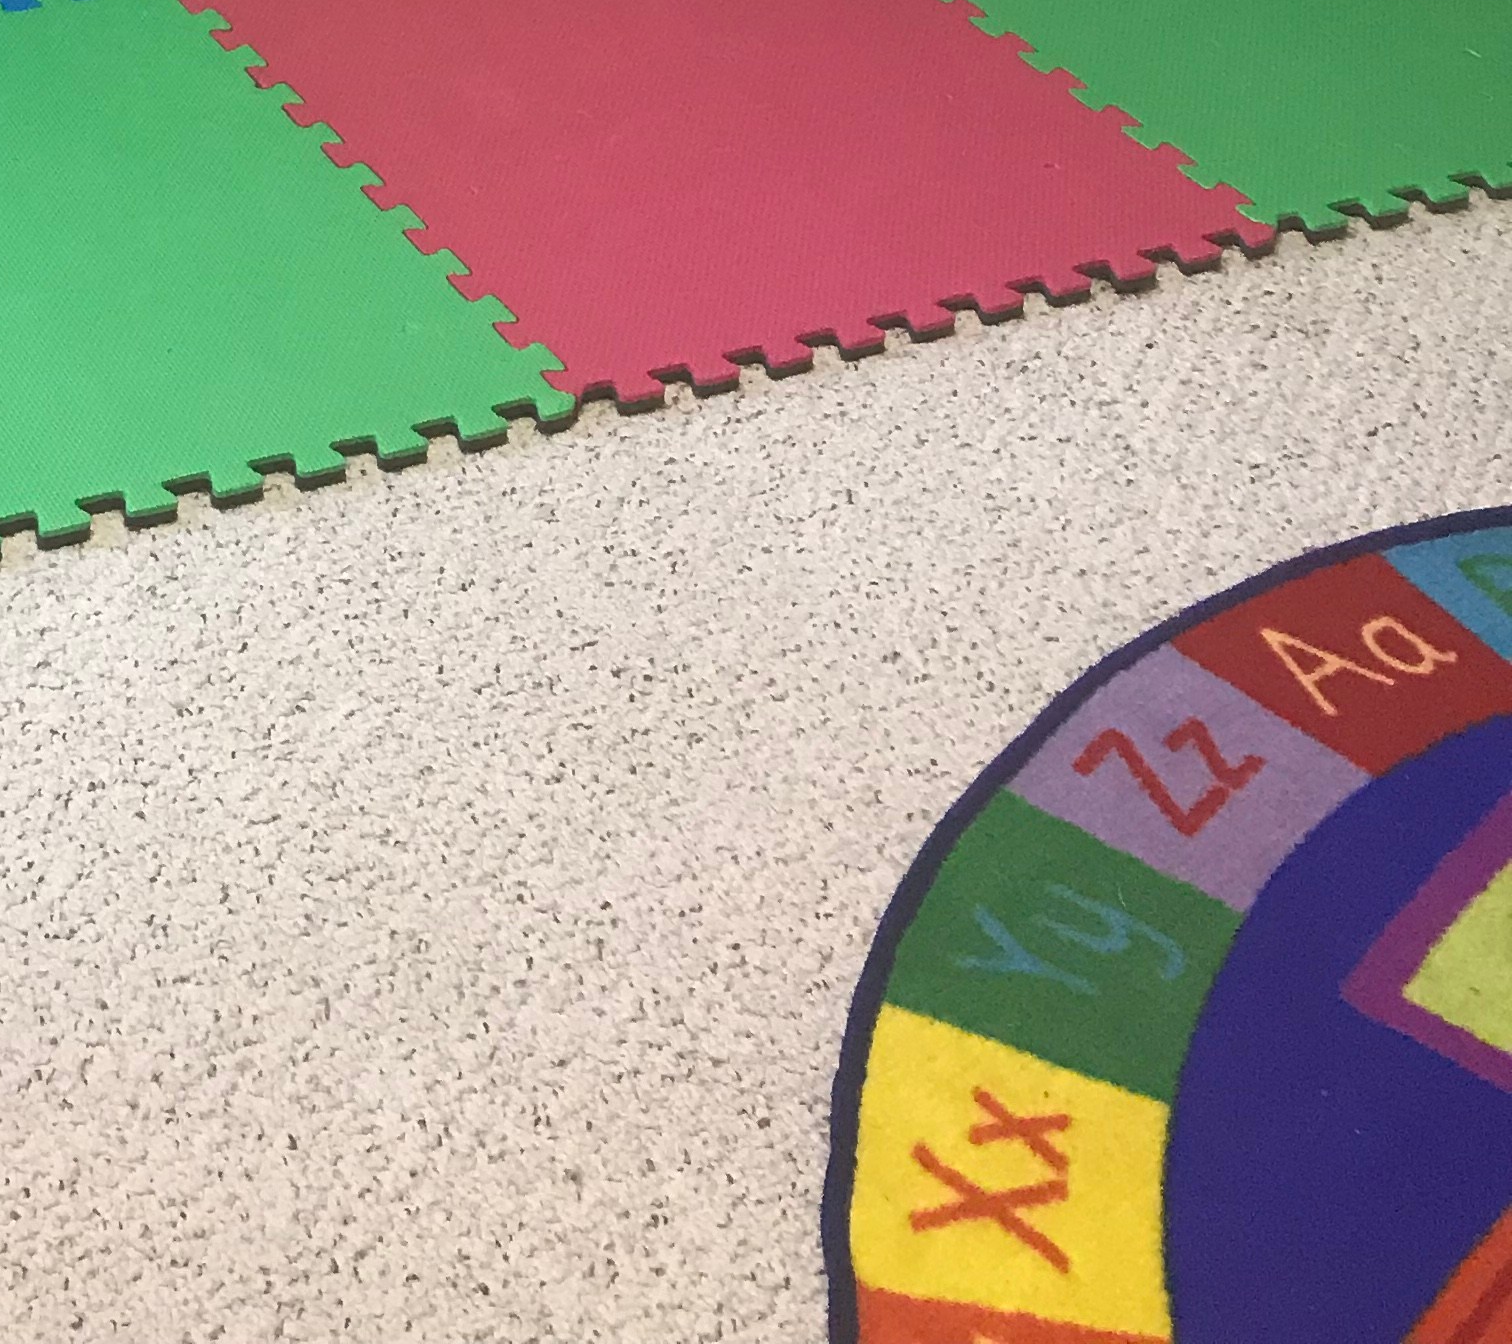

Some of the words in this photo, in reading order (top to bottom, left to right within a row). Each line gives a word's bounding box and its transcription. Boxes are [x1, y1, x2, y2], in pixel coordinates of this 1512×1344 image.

[1260, 614, 1459, 716] Aa
[1072, 715, 1266, 838] Zz
[954, 884, 1185, 996] Yy
[909, 1087, 1072, 1275] Xx
